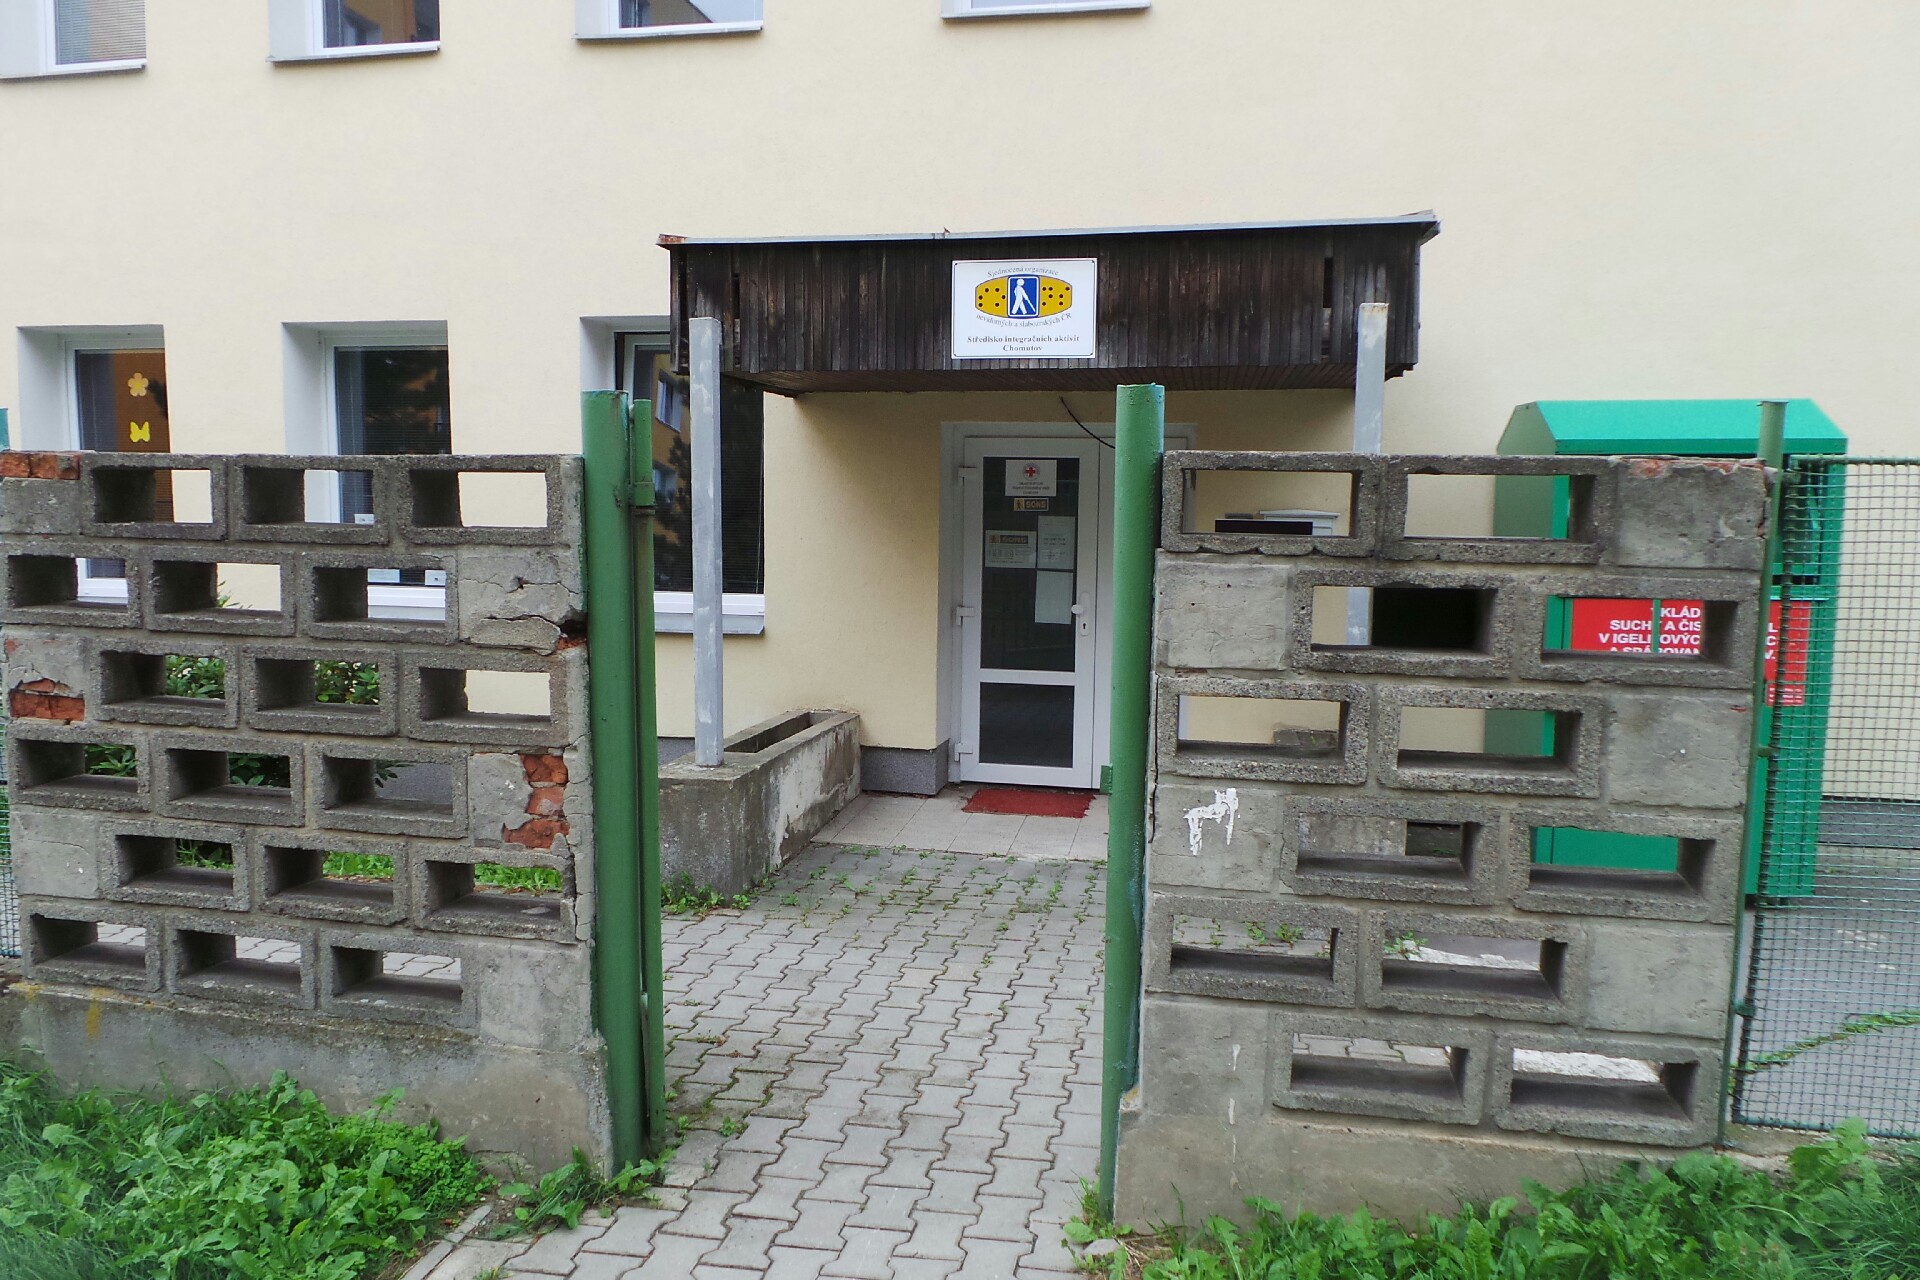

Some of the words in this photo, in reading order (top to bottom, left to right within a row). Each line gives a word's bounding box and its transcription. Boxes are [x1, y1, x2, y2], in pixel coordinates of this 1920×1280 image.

[987, 265, 1024, 277] Sjednocená
[1024, 266, 1059, 276] organizace
[976, 314, 1013, 327] nevidomých
[1019, 317, 1060, 328] slabozrakých
[1061, 312, 1072, 321] ČR
[967, 335, 1003, 343] Středisko
[1004, 335, 1052, 344] integračních
[1054, 334, 1080, 342] aktivit
[1002, 344, 1043, 352] Chomutov
[1650, 605, 1701, 618] KLÁD
[1609, 619, 1662, 631] SUCH
[1664, 621, 1676, 631] A
[1598, 633, 1610, 644] V
[1612, 632, 1701, 645] IGELIOVÝC
